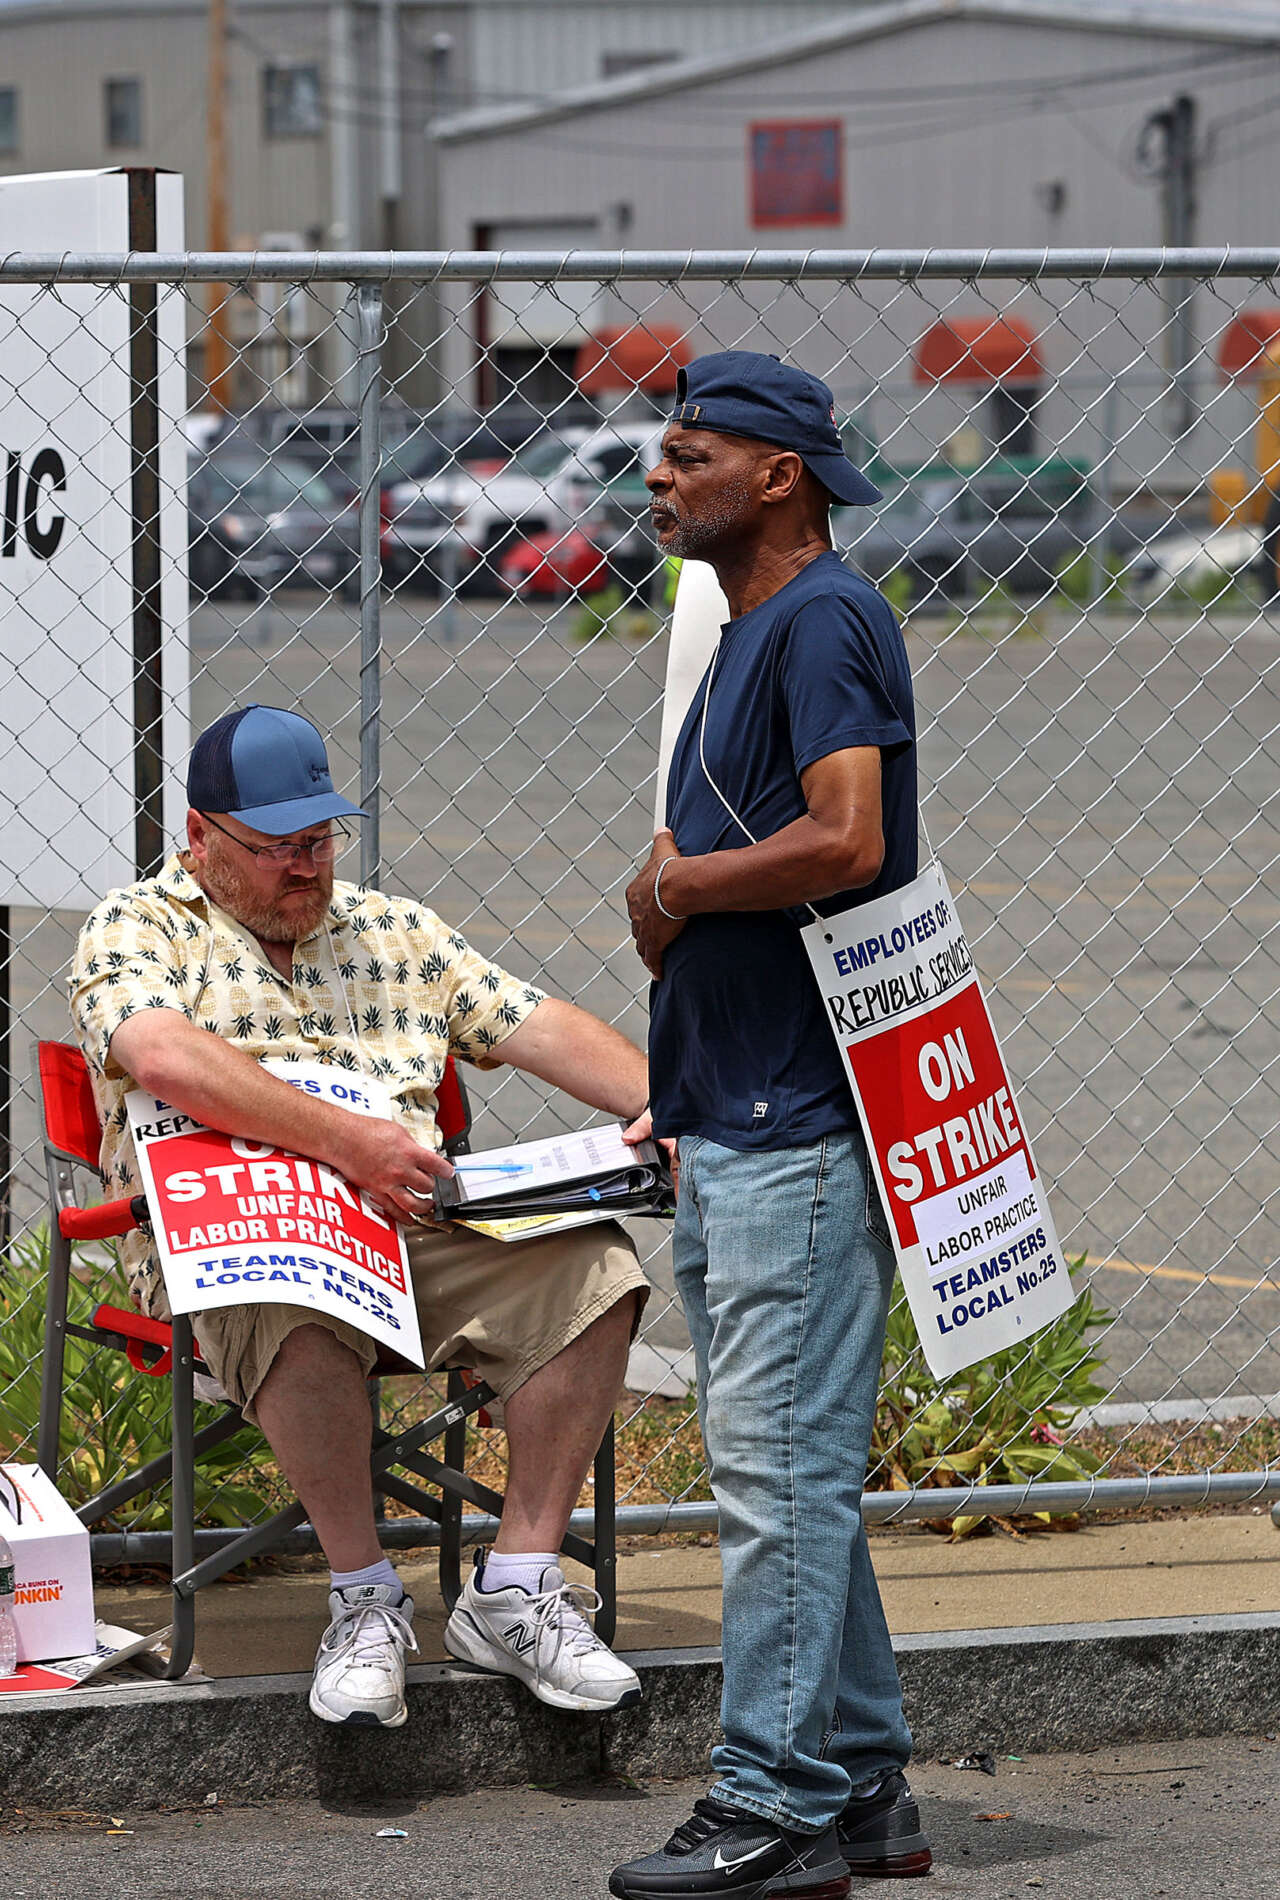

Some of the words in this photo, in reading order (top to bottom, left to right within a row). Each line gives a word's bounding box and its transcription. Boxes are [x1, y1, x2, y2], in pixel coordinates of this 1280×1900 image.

[832, 909, 936, 977] EMPLOYEES
[934, 899, 952, 928] OF:
[827, 965, 928, 1035] REPUBLIC
[929, 934, 973, 996] SERVICES
[330, 1083, 371, 1109] OF:
[918, 1026, 975, 1102] ON
[887, 1086, 1021, 1202] STRIKE
[236, 1195, 345, 1228] UNFAIR
[926, 1226, 984, 1266] LABOR
[985, 1194, 1038, 1240] PRACTICE
[957, 1175, 1008, 1215] UNFAIR
[170, 1219, 270, 1251] LABOR
[276, 1218, 405, 1290] PRACTICE
[197, 1255, 394, 1309] TEAMSTERS
[933, 1227, 1047, 1303] TEAMSTERS
[195, 1270, 312, 1289] LOCAL
[322, 1278, 401, 1330] No.25
[936, 1284, 1014, 1335] LOCAL
[1016, 1253, 1058, 1296] No.25
